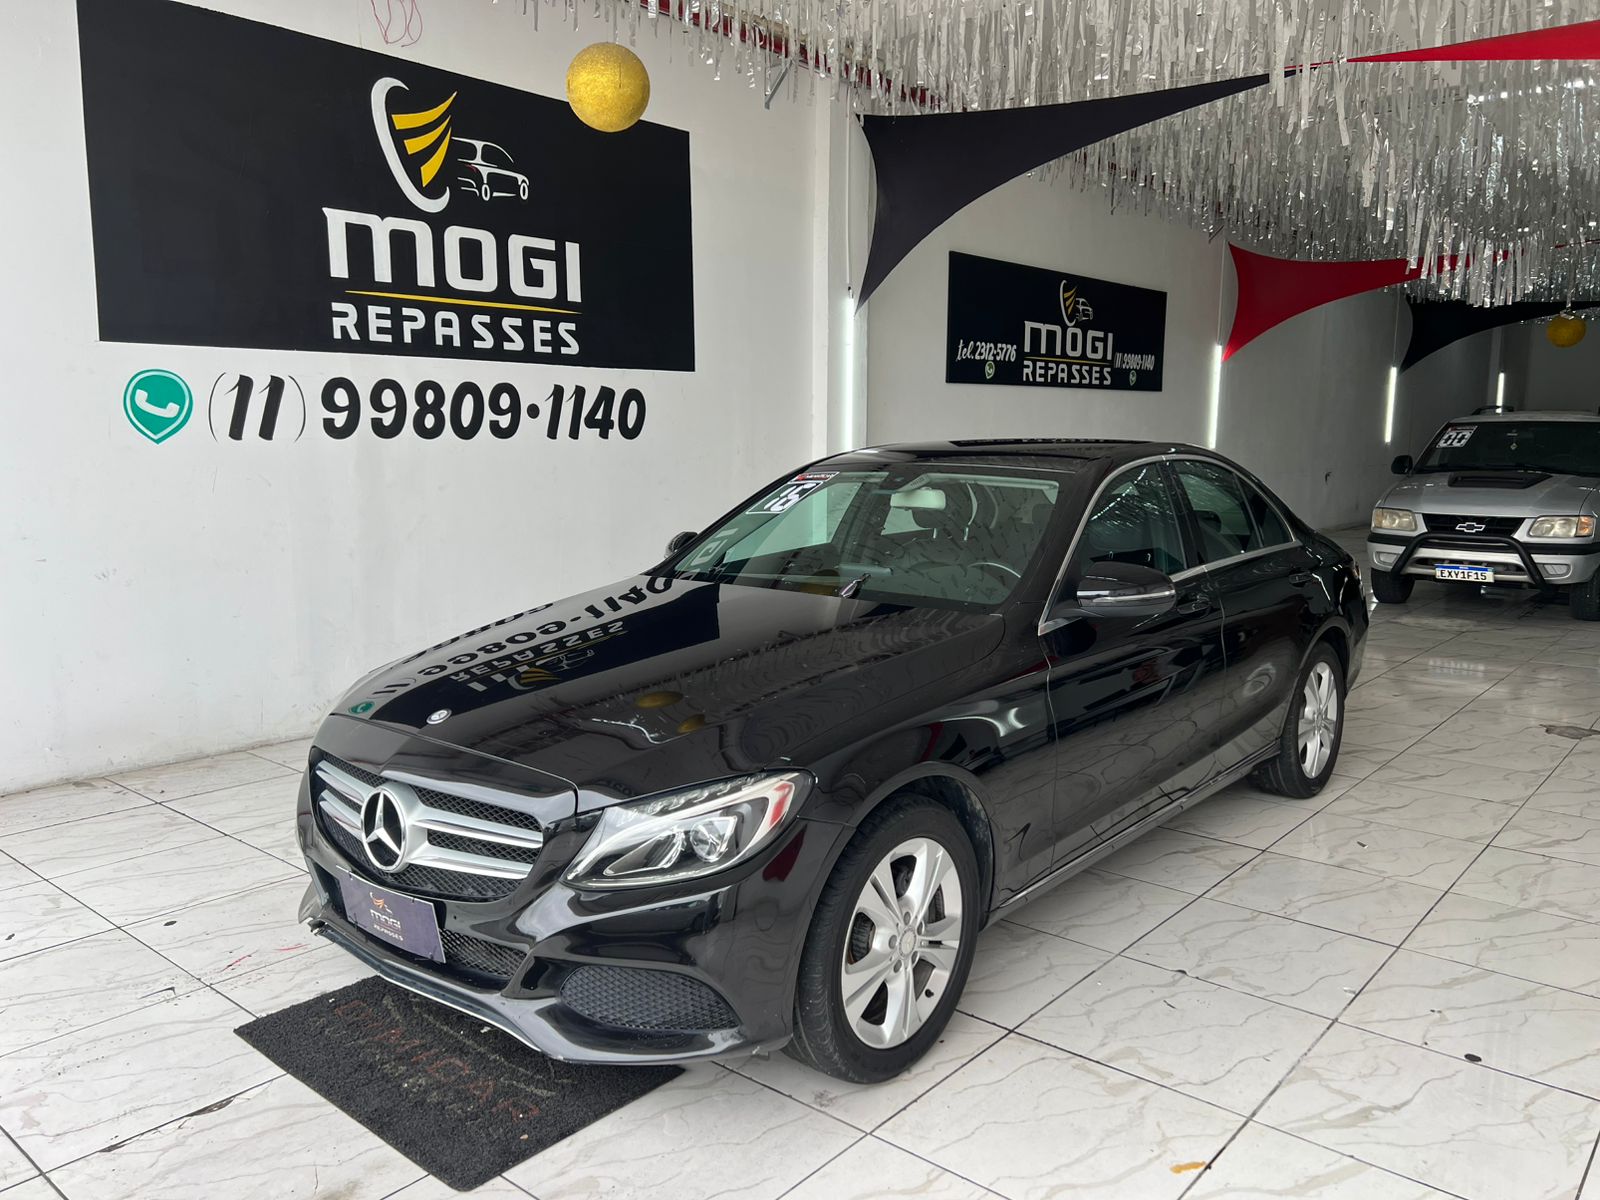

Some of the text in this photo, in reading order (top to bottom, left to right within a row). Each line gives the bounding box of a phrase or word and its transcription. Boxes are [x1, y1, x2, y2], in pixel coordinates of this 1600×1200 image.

[322, 207, 582, 303] MOGI
[331, 302, 580, 356] REPASSES
[1023, 320, 1114, 361] MOGI
[1022, 360, 1112, 386] REPASSES
[208, 371, 306, 443] (11)
[1440, 569, 1487, 581] EXY1F15
